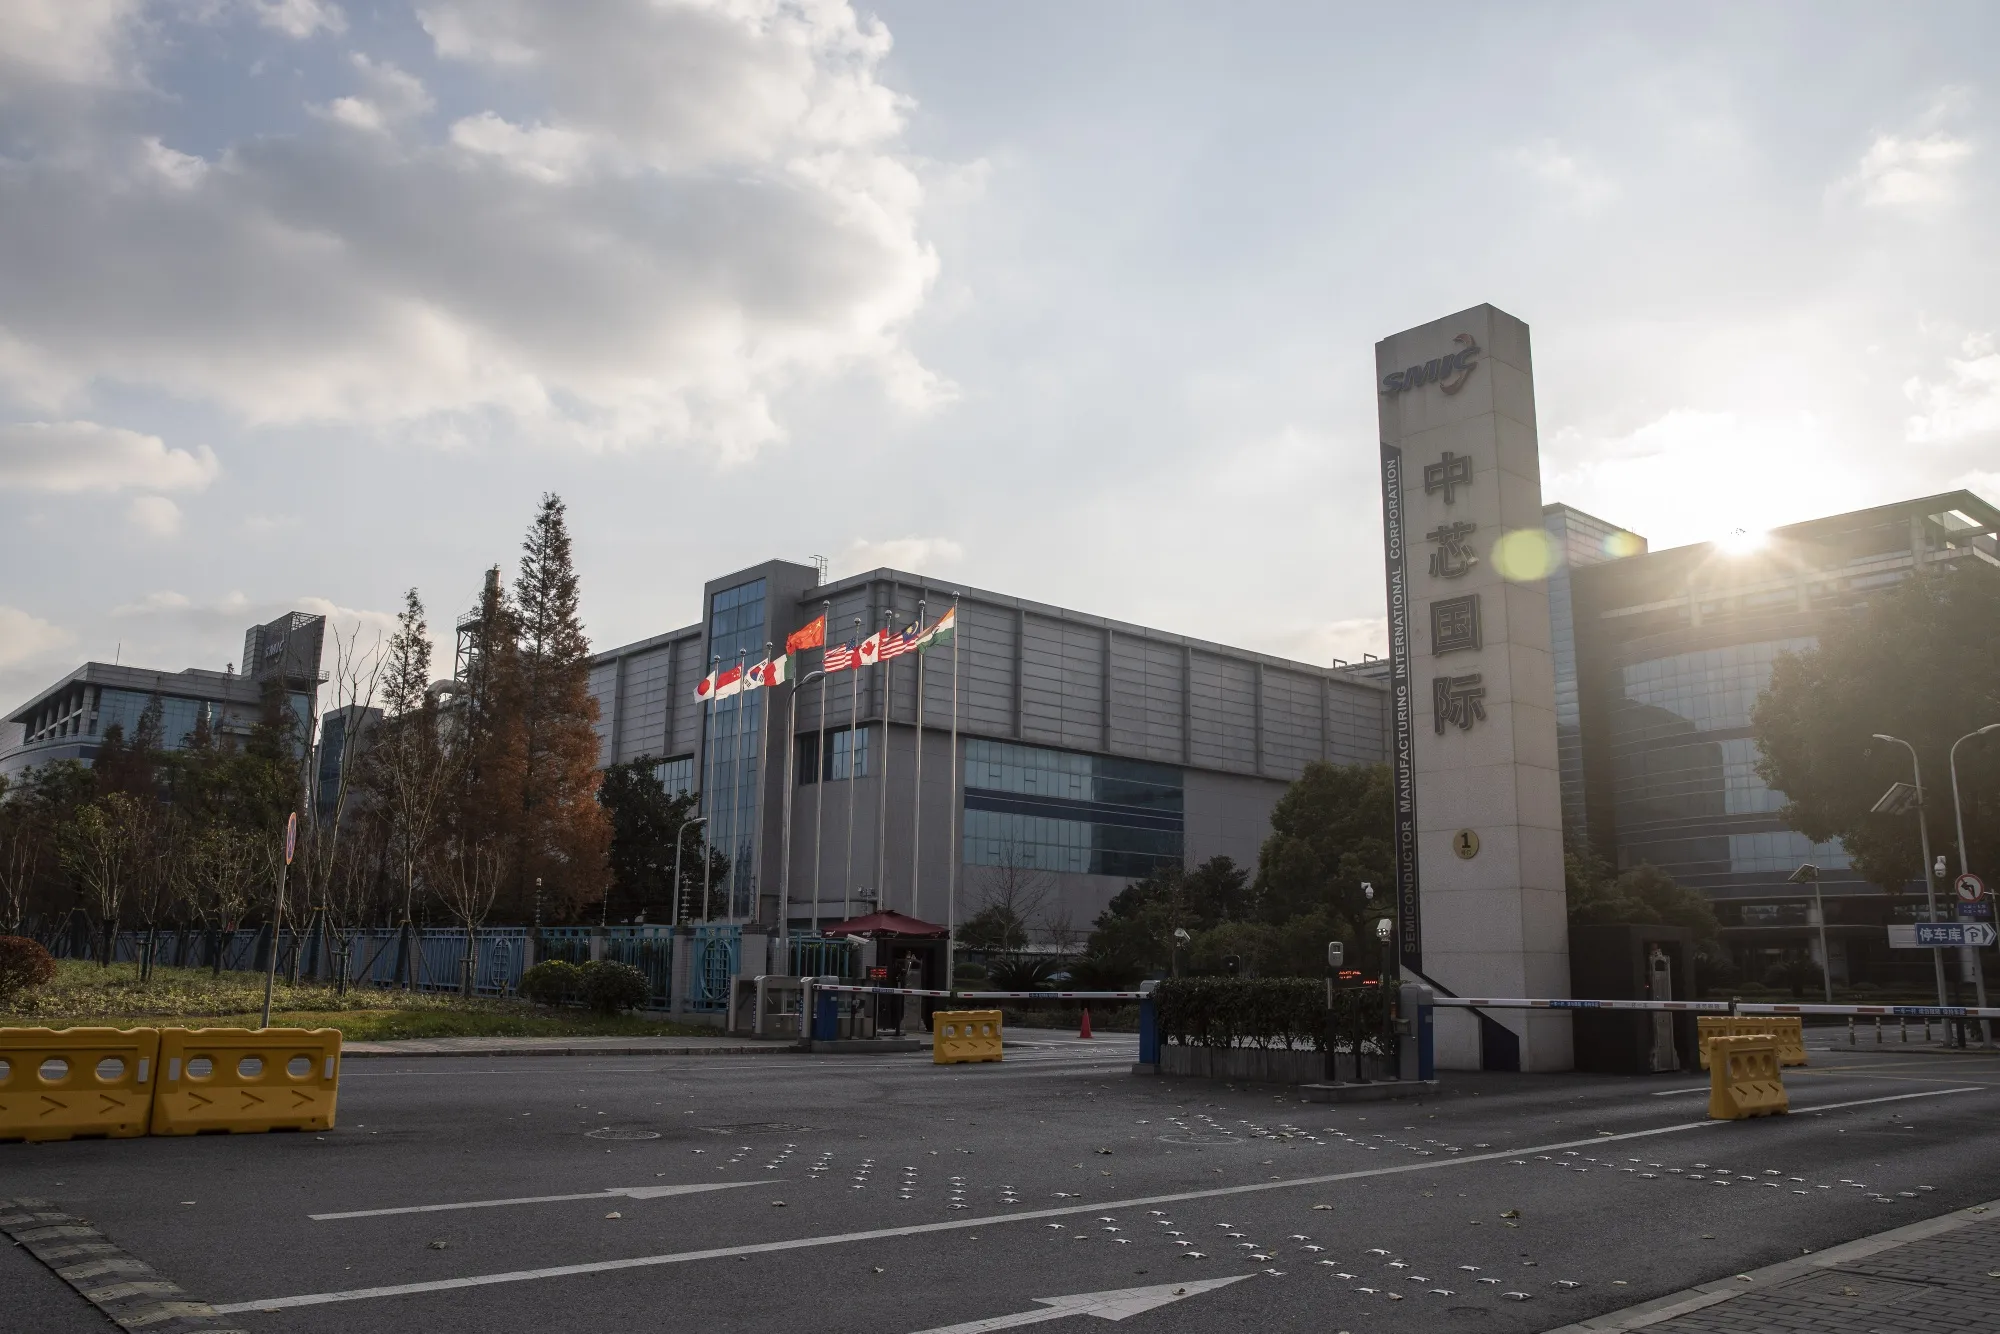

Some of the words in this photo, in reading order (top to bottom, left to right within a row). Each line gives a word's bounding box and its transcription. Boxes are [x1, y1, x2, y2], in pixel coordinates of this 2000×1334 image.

[1380, 345, 1480, 395] SMIC
[1387, 459, 1400, 559] CORPORATION
[1391, 565, 1406, 679] INTERNATIONAL
[1423, 450, 1487, 736] 中芯国际
[1396, 685, 1411, 813] MANUFACTURING
[1401, 820, 1416, 953] SEMICONDUCTOR
[1460, 832, 1472, 849] 1
[1919, 927, 1962, 942] 停车库
